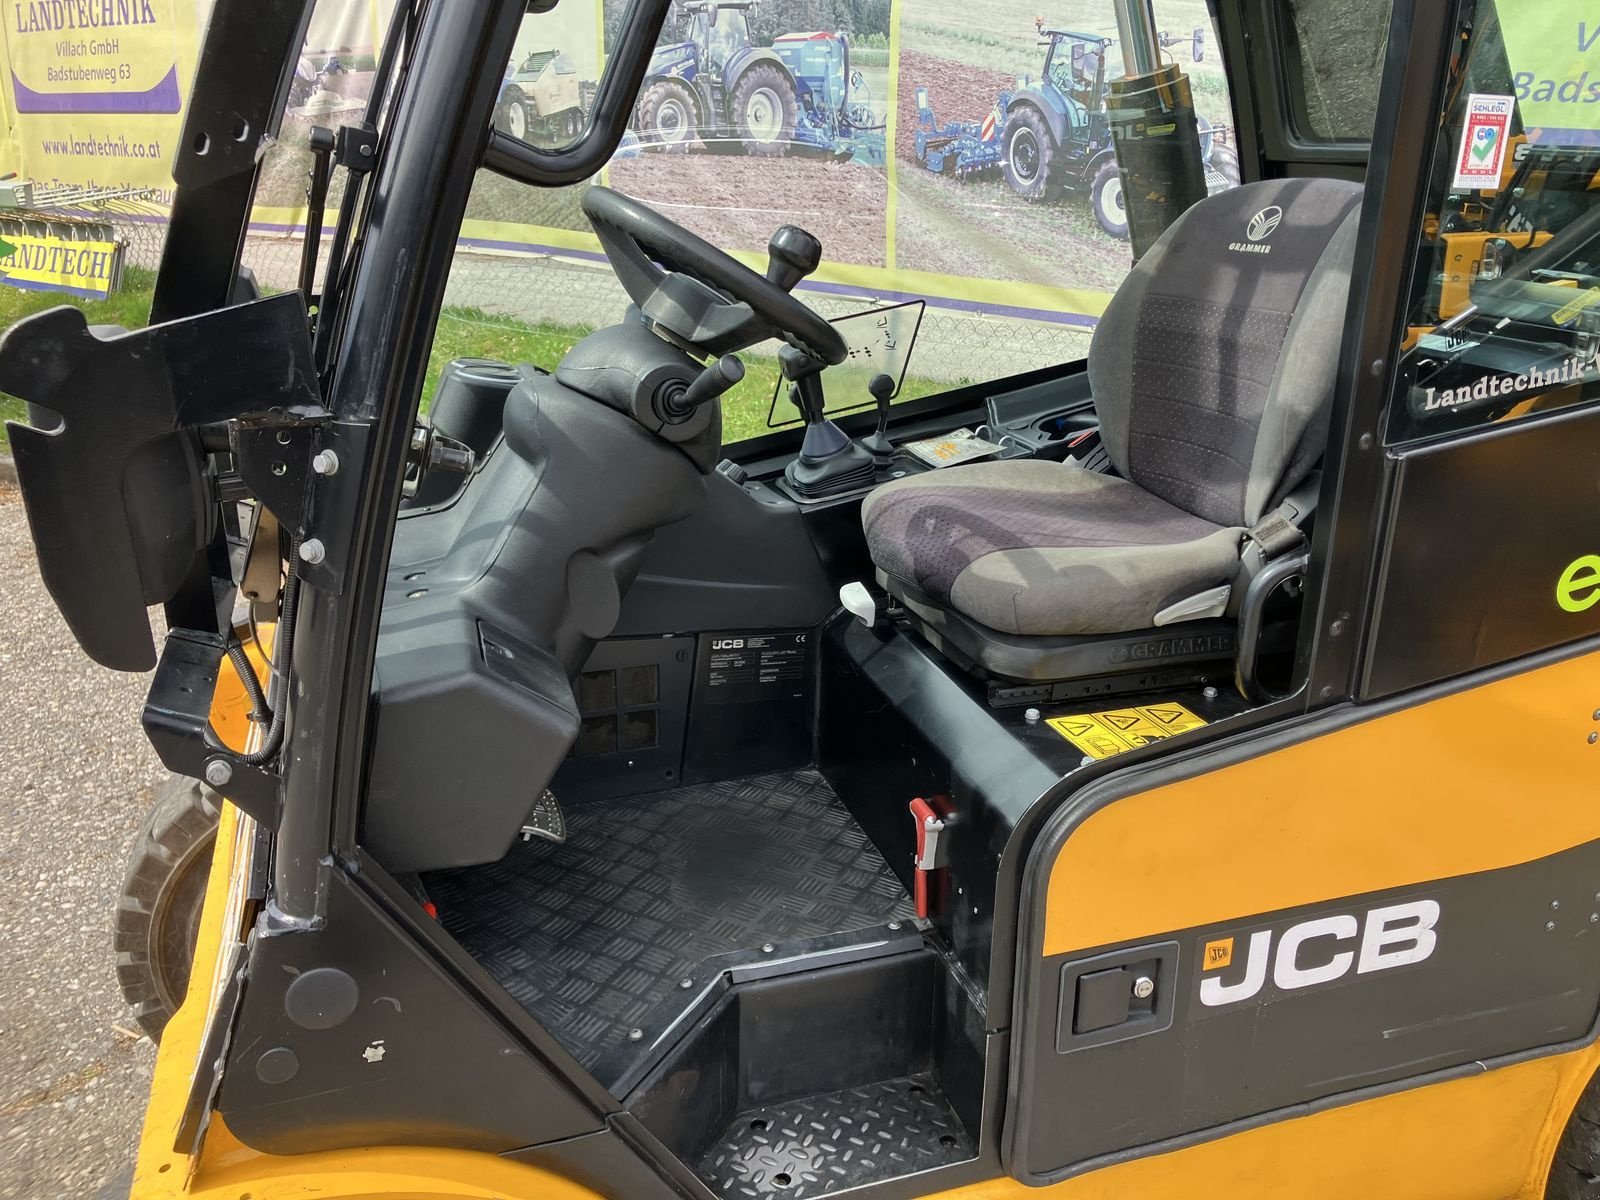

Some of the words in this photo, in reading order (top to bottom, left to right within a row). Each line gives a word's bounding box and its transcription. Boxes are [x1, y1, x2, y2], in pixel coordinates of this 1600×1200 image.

[15, 0, 157, 33] LANDTECHNIK
[56, 43, 87, 57] Villach
[89, 39, 119, 55] GmbH
[47, 66, 117, 83] Badstubenweg
[119, 64, 131, 80] 63
[42, 134, 161, 158] www.landtechnik.co.at
[1228, 242, 1271, 254] GRAMMER
[0, 243, 113, 280] ANDTECH
[1424, 352, 1600, 411] Landtechnik-
[712, 639, 744, 650] JCB
[1131, 634, 1233, 659] GRAMMER
[1200, 900, 1440, 1006] JCB
[1211, 947, 1228, 962] JCB
